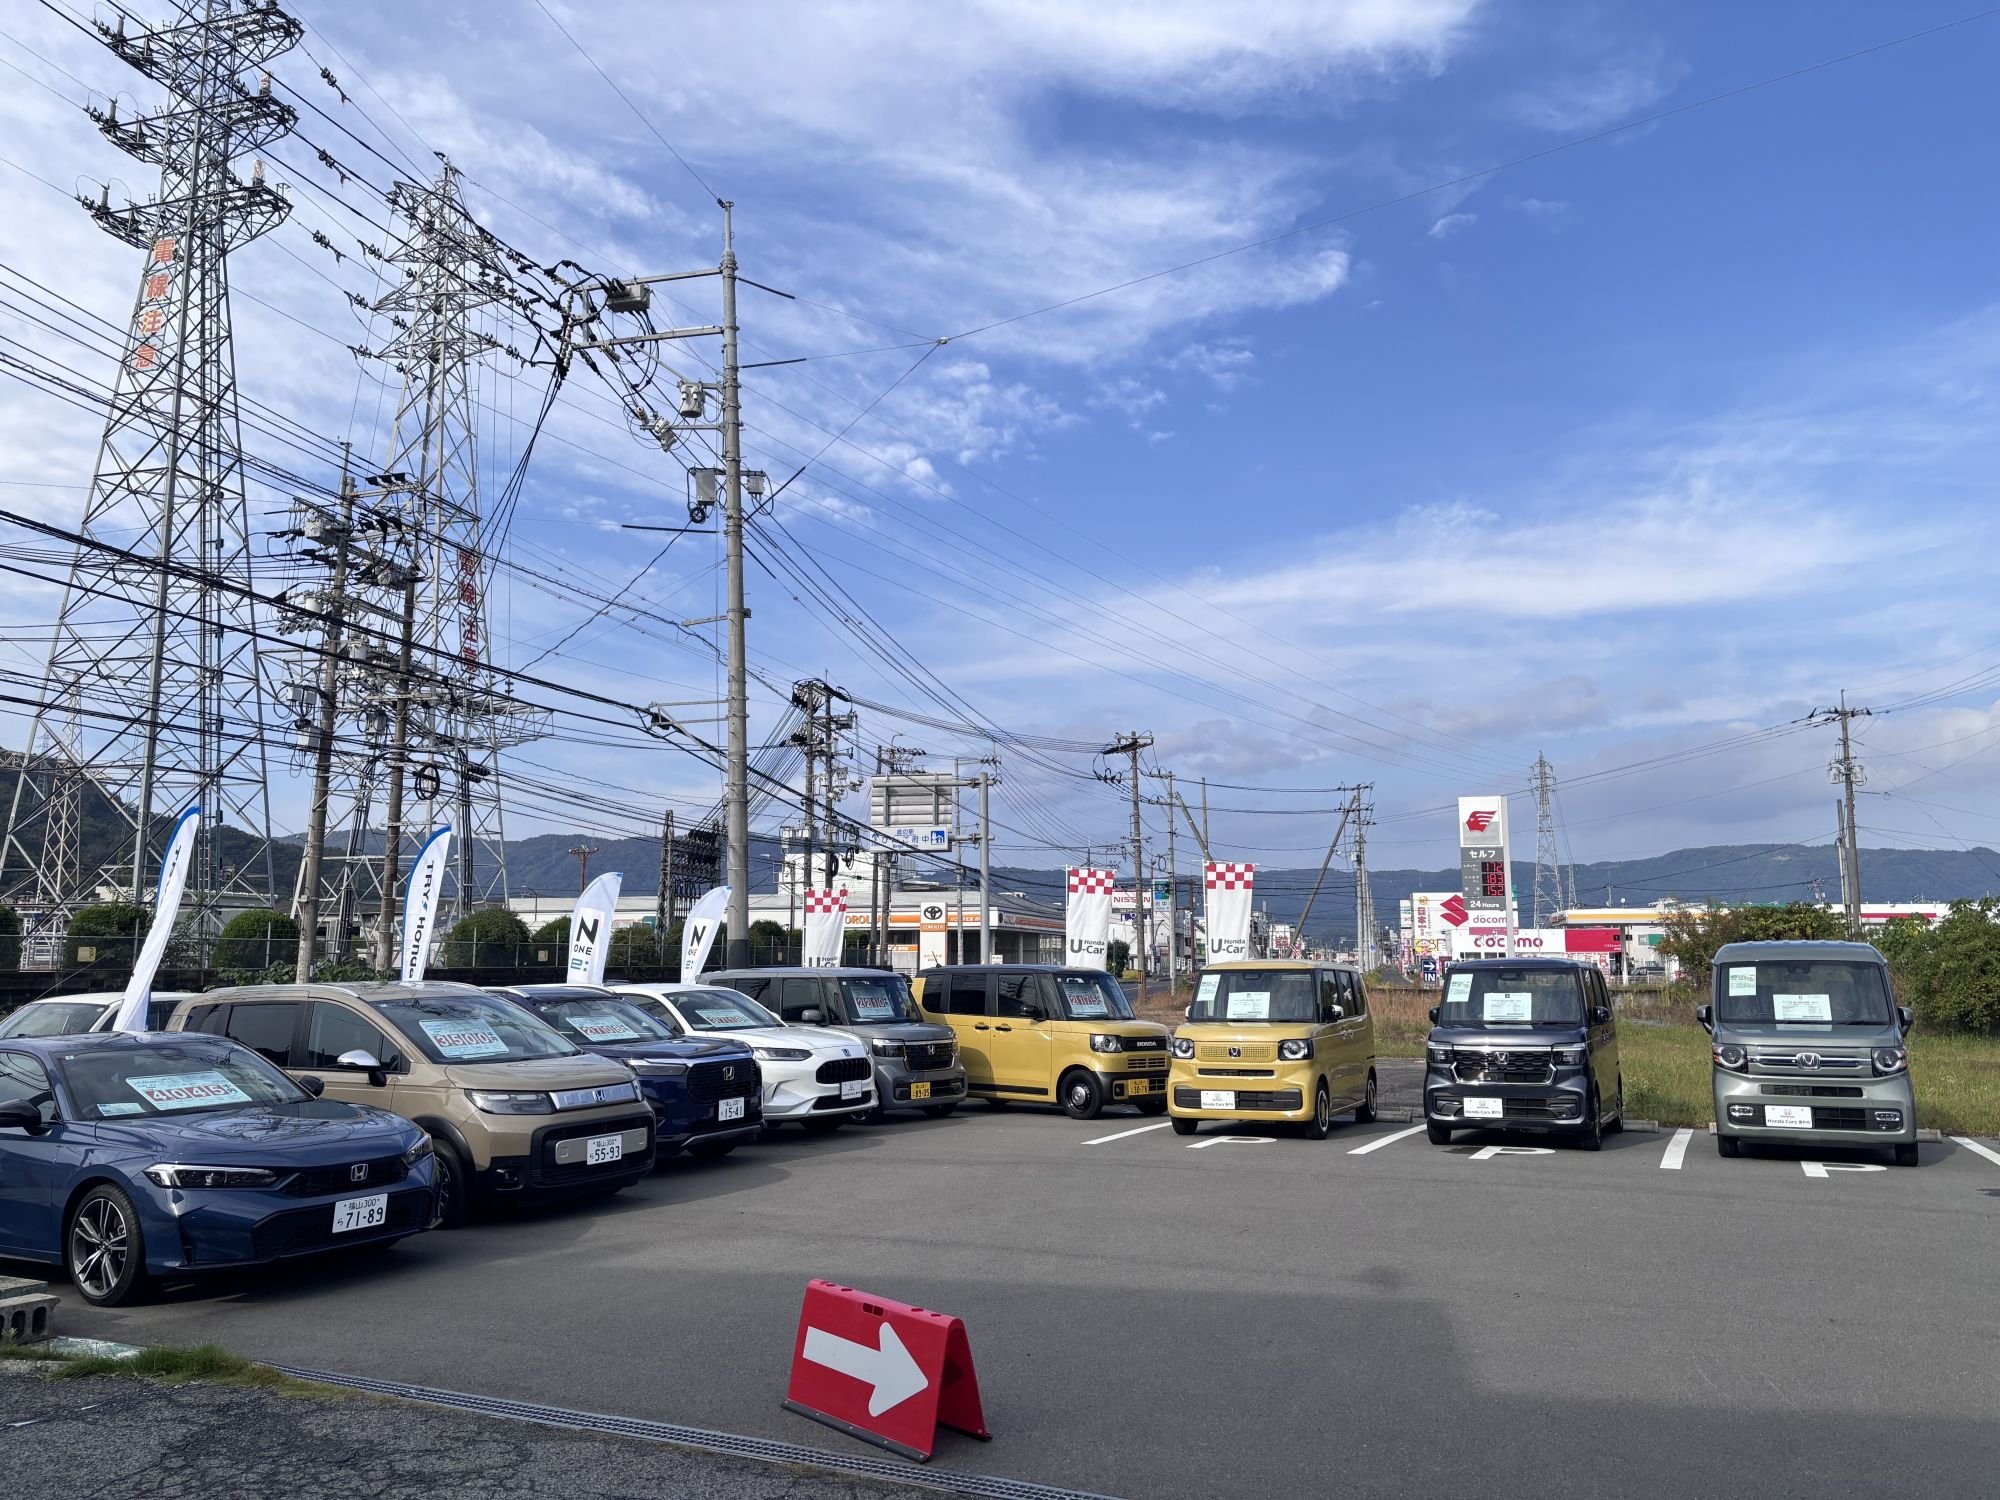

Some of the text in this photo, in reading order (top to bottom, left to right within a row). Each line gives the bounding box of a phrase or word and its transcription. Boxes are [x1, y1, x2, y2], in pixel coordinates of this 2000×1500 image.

[134, 238, 177, 369] 電線注意
[881, 835, 930, 845] びご府中
[1469, 850, 1496, 859] セルフ
[1486, 861, 1504, 872] 172
[1487, 873, 1504, 884] 183
[1487, 885, 1504, 896] 152
[1470, 900, 1481, 908] 24
[408, 860, 434, 979] TRY Honda
[1473, 915, 1507, 924] docom
[576, 916, 599, 945] N
[690, 925, 706, 947] N
[1070, 939, 1105, 954] U-Car
[1211, 938, 1246, 954] U-Car
[1474, 937, 1543, 948] docmo
[573, 944, 593, 956] ONE
[1425, 973, 1436, 982] IN
[436, 1032, 489, 1047] 3500
[150, 1085, 225, 1101] 4045
[725, 1105, 742, 1119] 15-41
[594, 1145, 620, 1162] 55-93
[1468, 1146, 1557, 1160] P
[1800, 1161, 1888, 1178] P
[345, 1206, 384, 1229] 71-89
